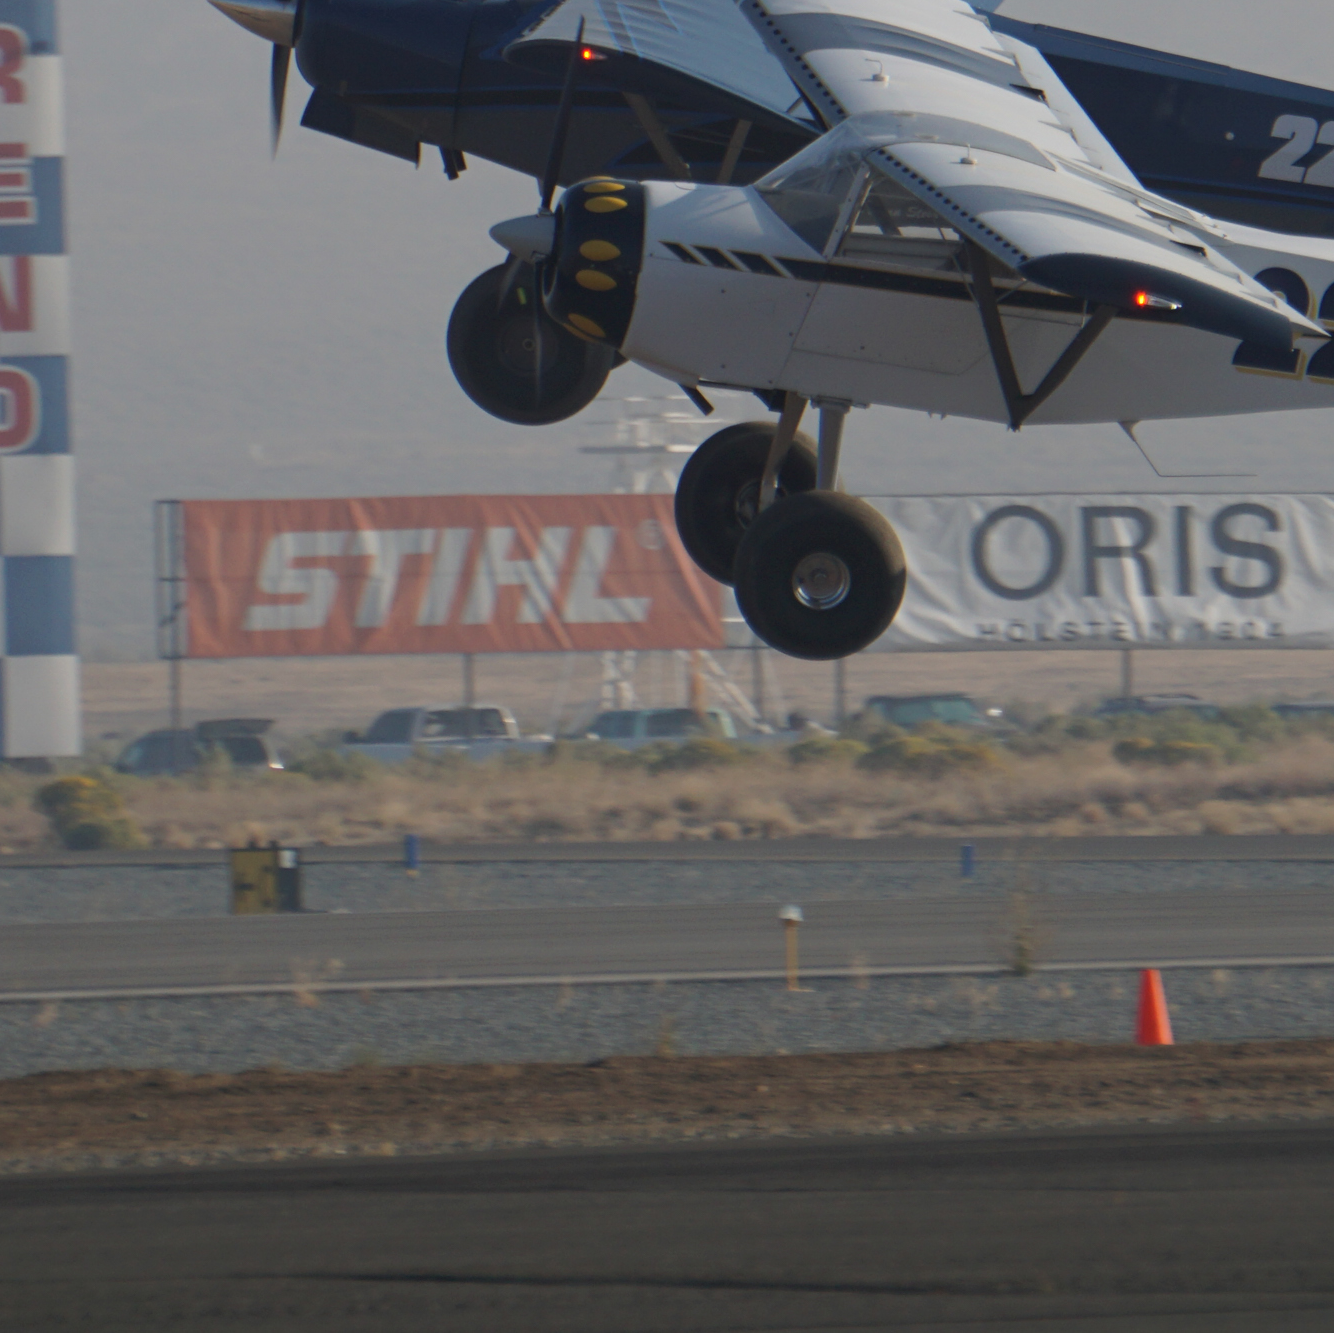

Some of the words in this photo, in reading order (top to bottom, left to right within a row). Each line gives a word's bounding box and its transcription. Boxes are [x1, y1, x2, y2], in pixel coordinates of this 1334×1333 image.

[241, 526, 654, 632] STIHL
[971, 503, 1284, 601] ORIS
[975, 618, 1169, 643] HÖLSTEN
